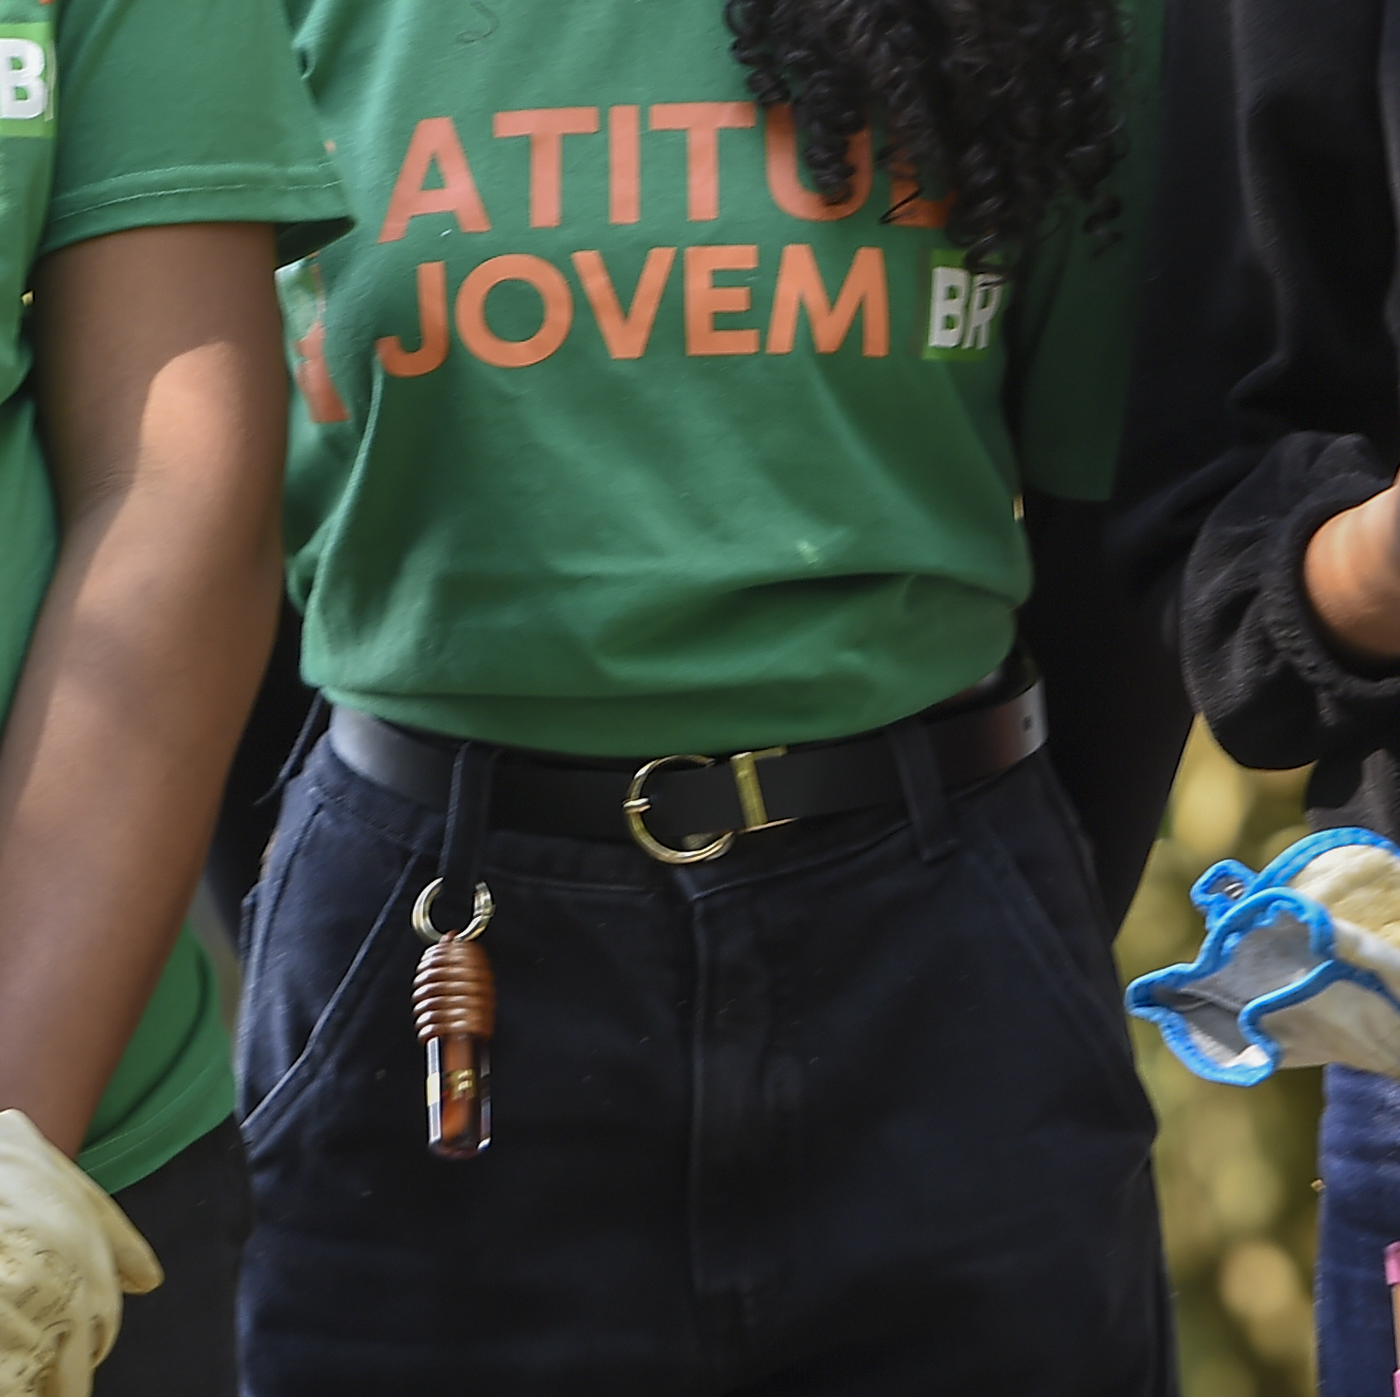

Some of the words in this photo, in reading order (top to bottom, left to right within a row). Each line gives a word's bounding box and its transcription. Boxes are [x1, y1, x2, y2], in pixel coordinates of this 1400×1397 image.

[377, 100, 958, 244] ATITU
[377, 244, 889, 377] JOVEM
[927, 266, 1002, 350] BR
